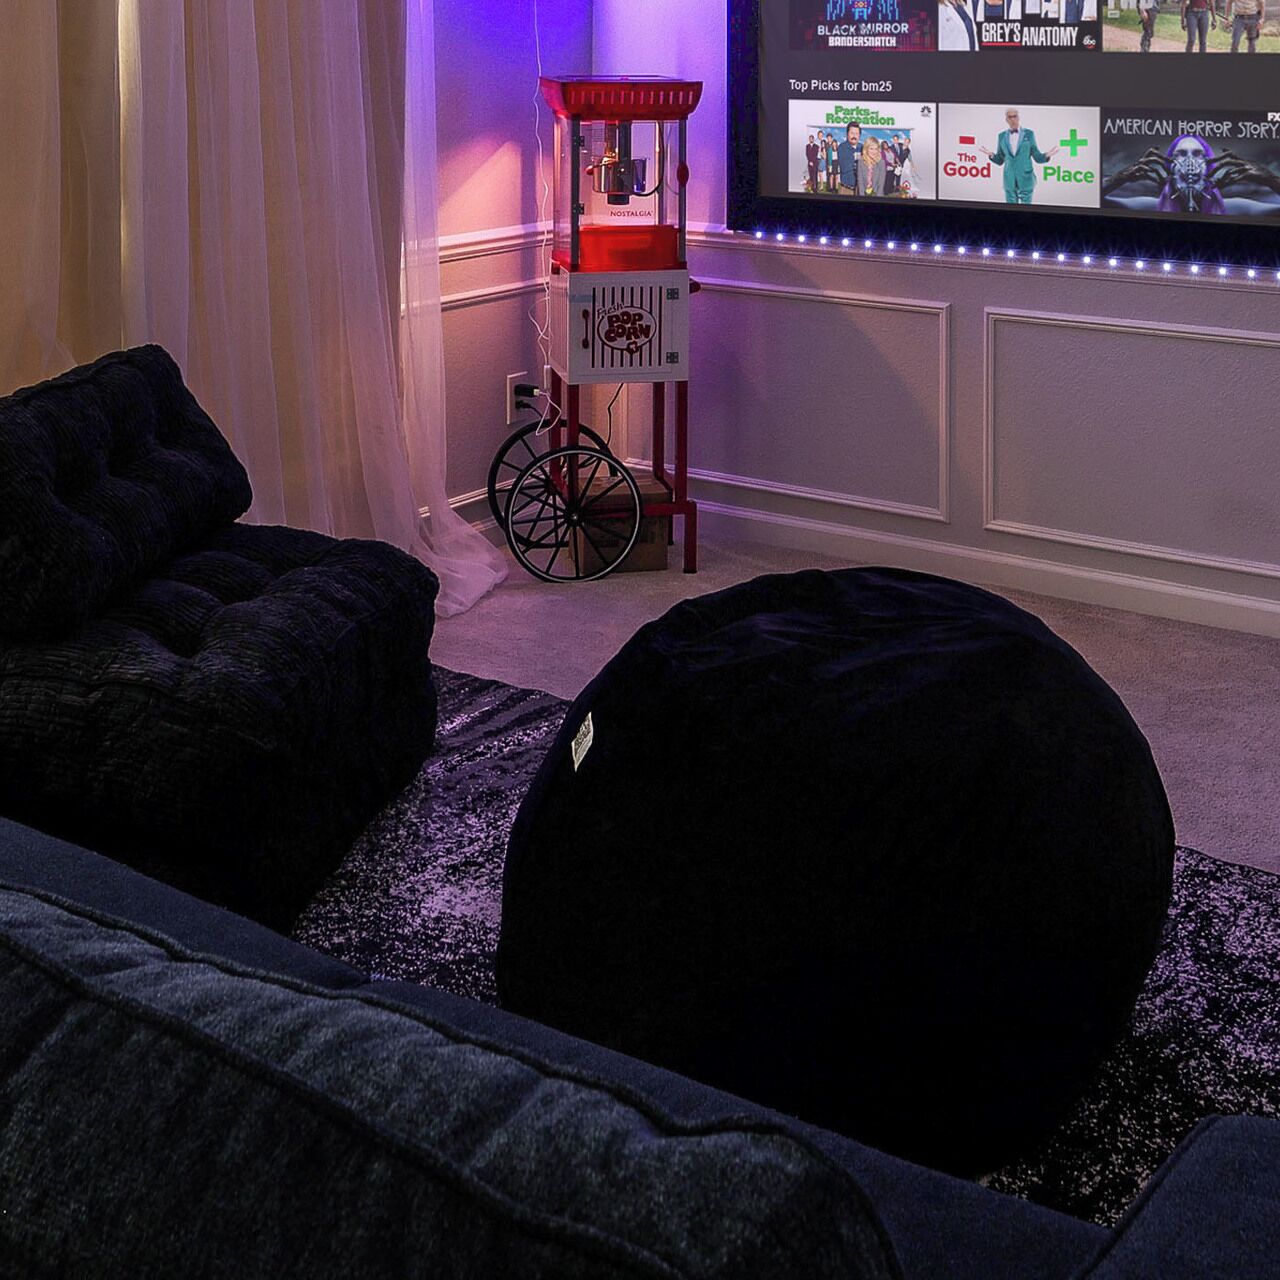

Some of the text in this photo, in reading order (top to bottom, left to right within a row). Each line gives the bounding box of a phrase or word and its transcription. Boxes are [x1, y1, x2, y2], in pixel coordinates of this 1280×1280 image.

[817, 22, 909, 36] BLACK MIRROR
[1022, 26, 1079, 46] ANATOMY
[828, 36, 896, 47] BANDERSNATCH
[789, 79, 892, 93] Top Picks for bm25
[826, 112, 895, 125] Recreation
[834, 105, 870, 116] Parks
[1104, 118, 1172, 135] AMERICAN
[957, 152, 977, 164] The
[943, 161, 991, 179] Good
[1043, 165, 1095, 184] Place
[597, 302, 623, 319] Fresh
[607, 311, 644, 328] POP
[604, 323, 651, 342] CORN
